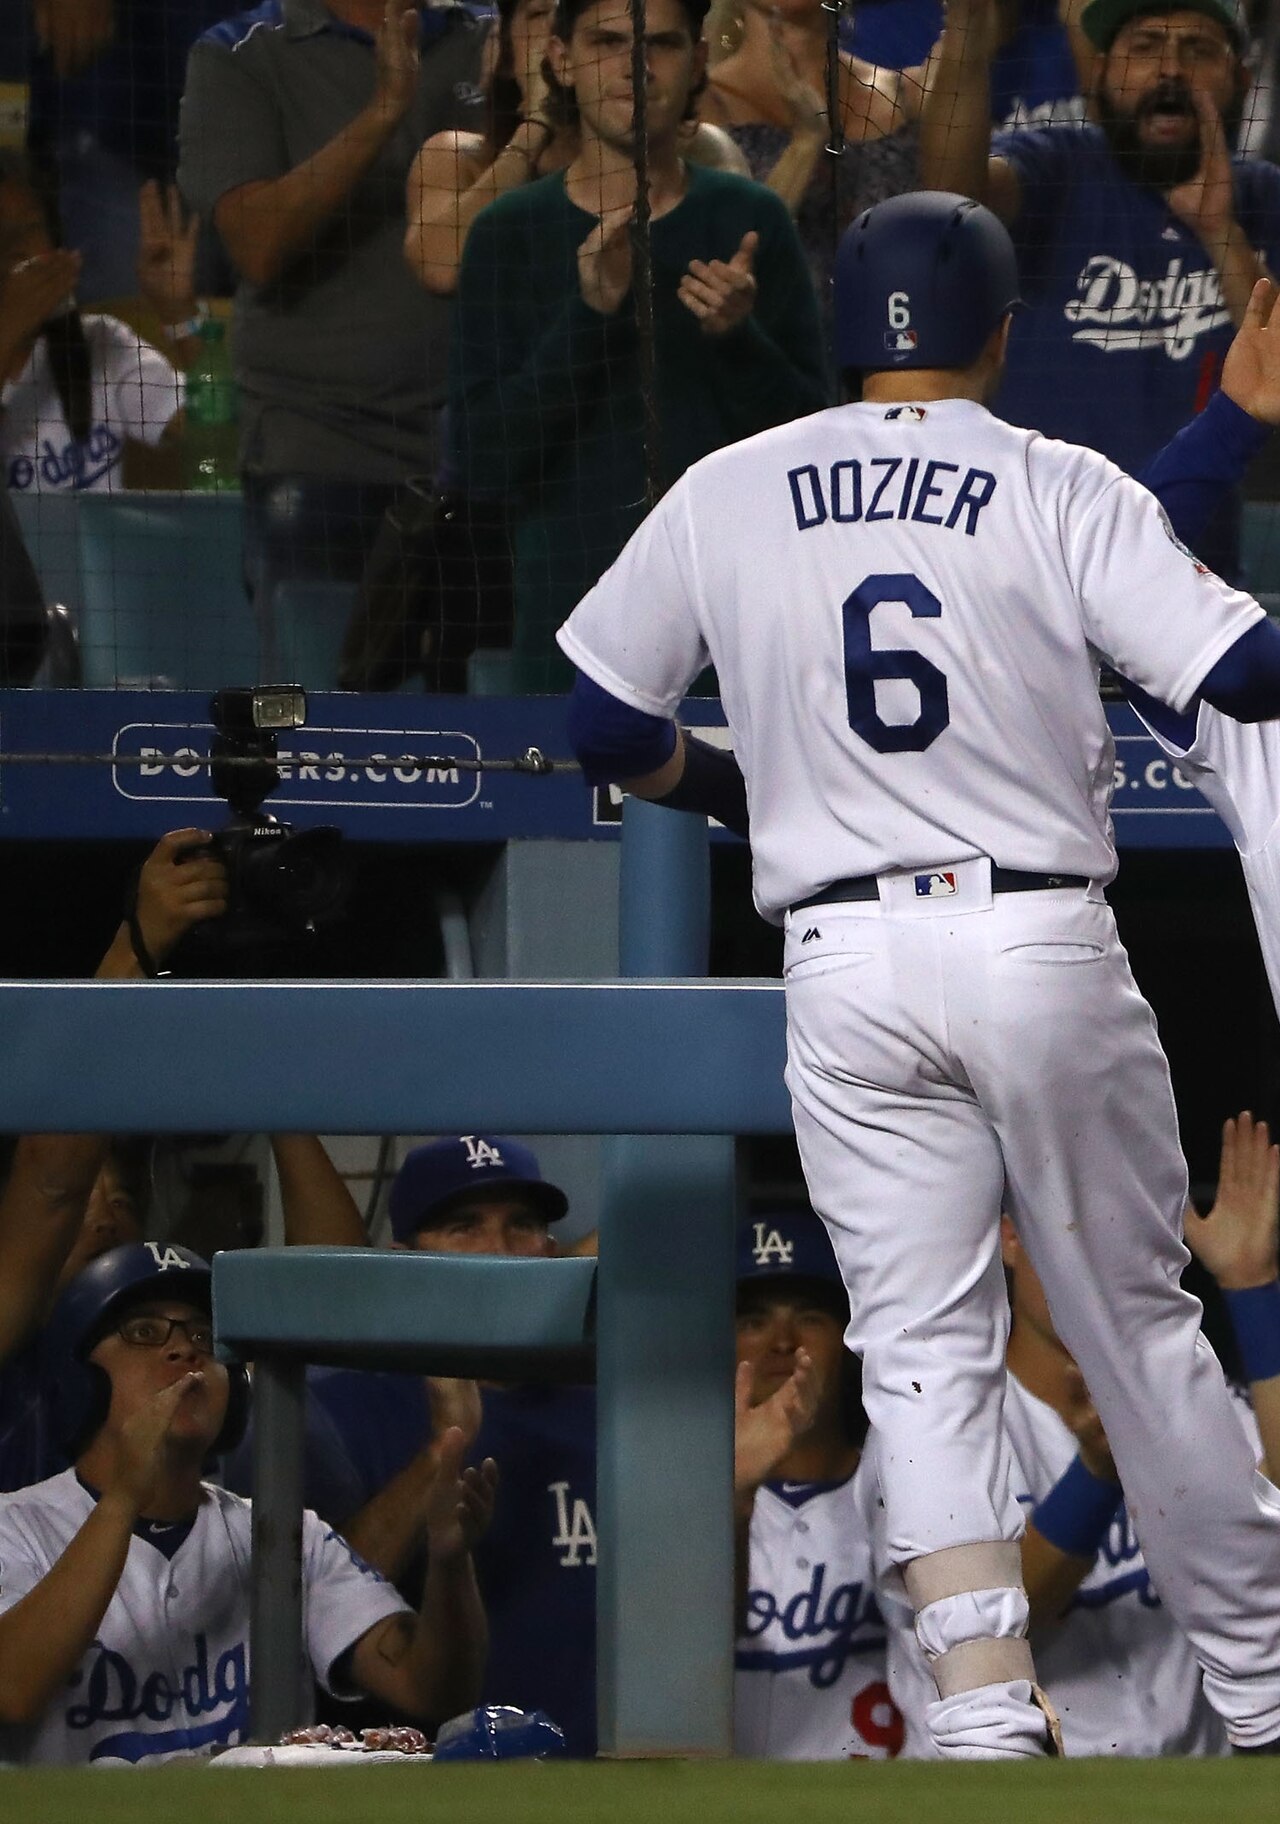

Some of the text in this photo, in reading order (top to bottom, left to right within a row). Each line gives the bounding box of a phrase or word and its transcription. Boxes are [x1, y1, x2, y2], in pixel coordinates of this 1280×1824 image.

[888, 291, 910, 329] 6
[787, 457, 997, 536] DOZIER
[842, 573, 950, 753] 6
[139, 747, 460, 784] DOERS.COM
[254, 828, 282, 836] Nikon
[460, 1135, 504, 1168] LA
[143, 1241, 191, 1271] LA
[752, 1222, 794, 1265] LA
[548, 1481, 597, 1567] LA
